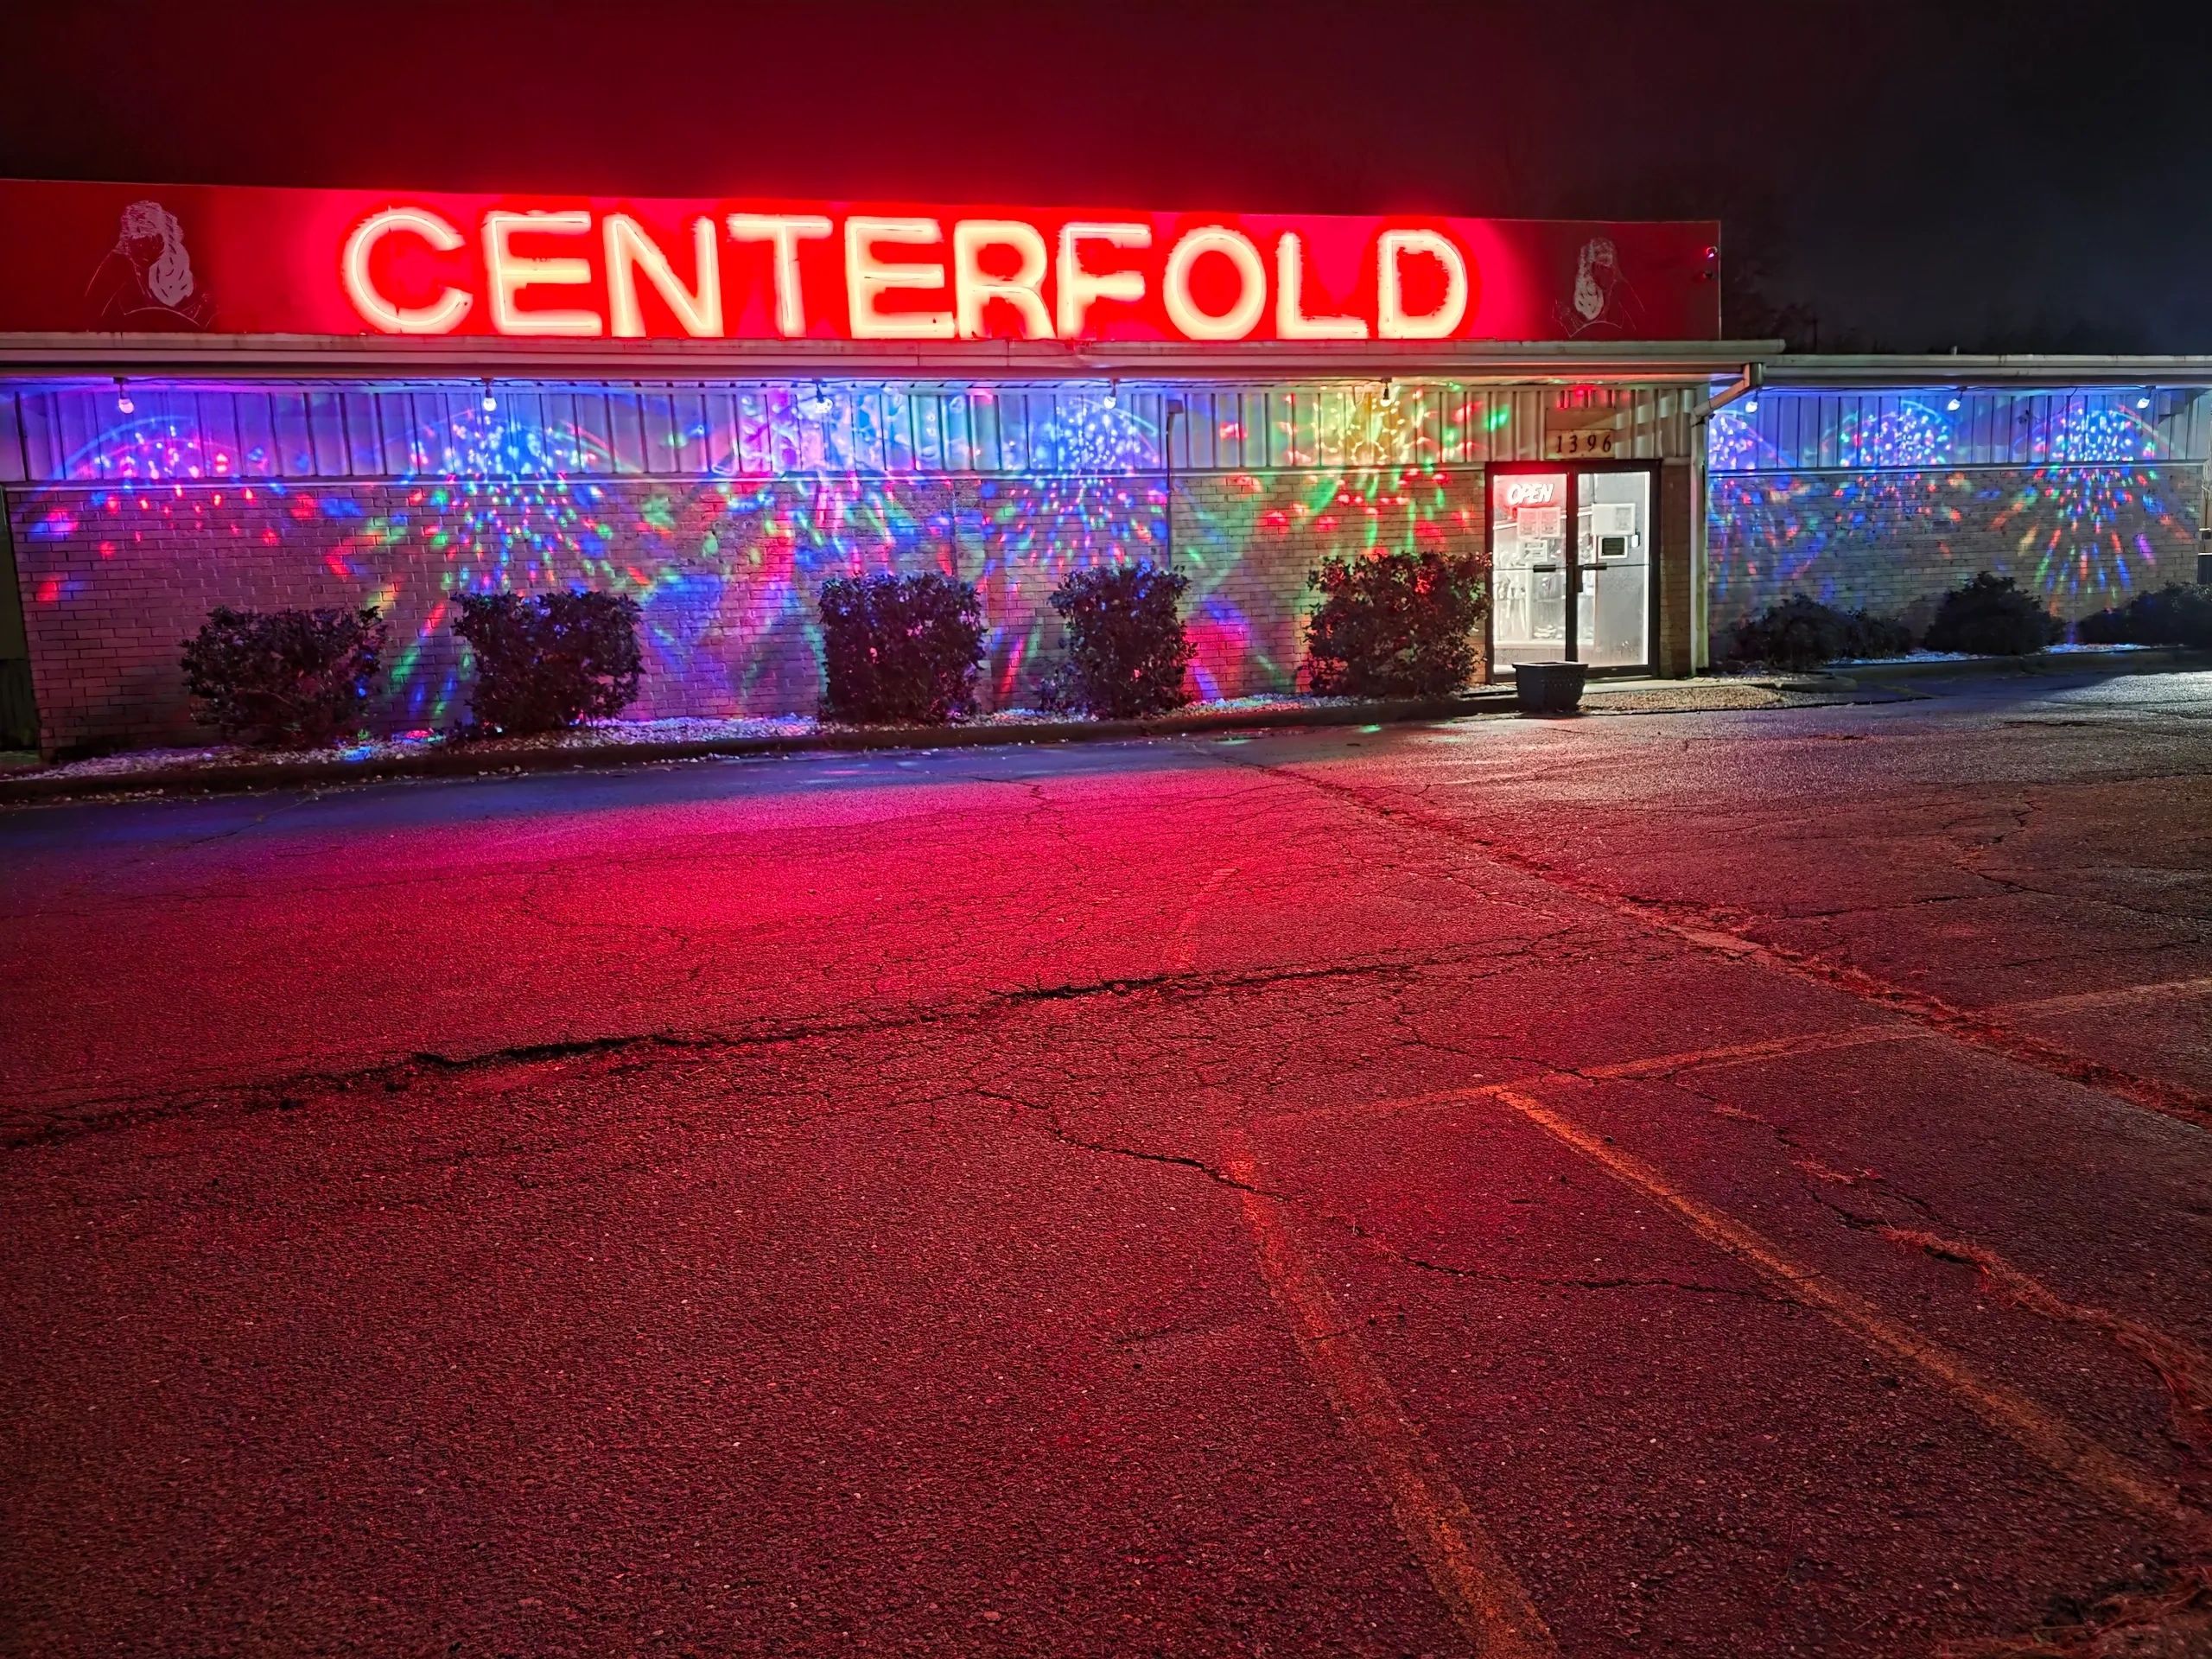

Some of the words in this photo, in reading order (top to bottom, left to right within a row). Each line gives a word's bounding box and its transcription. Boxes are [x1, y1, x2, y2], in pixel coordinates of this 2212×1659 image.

[342, 206, 1469, 340] CENTERFOLD
[1556, 434, 1612, 454] 1396
[1507, 483, 1554, 505] OPEN
